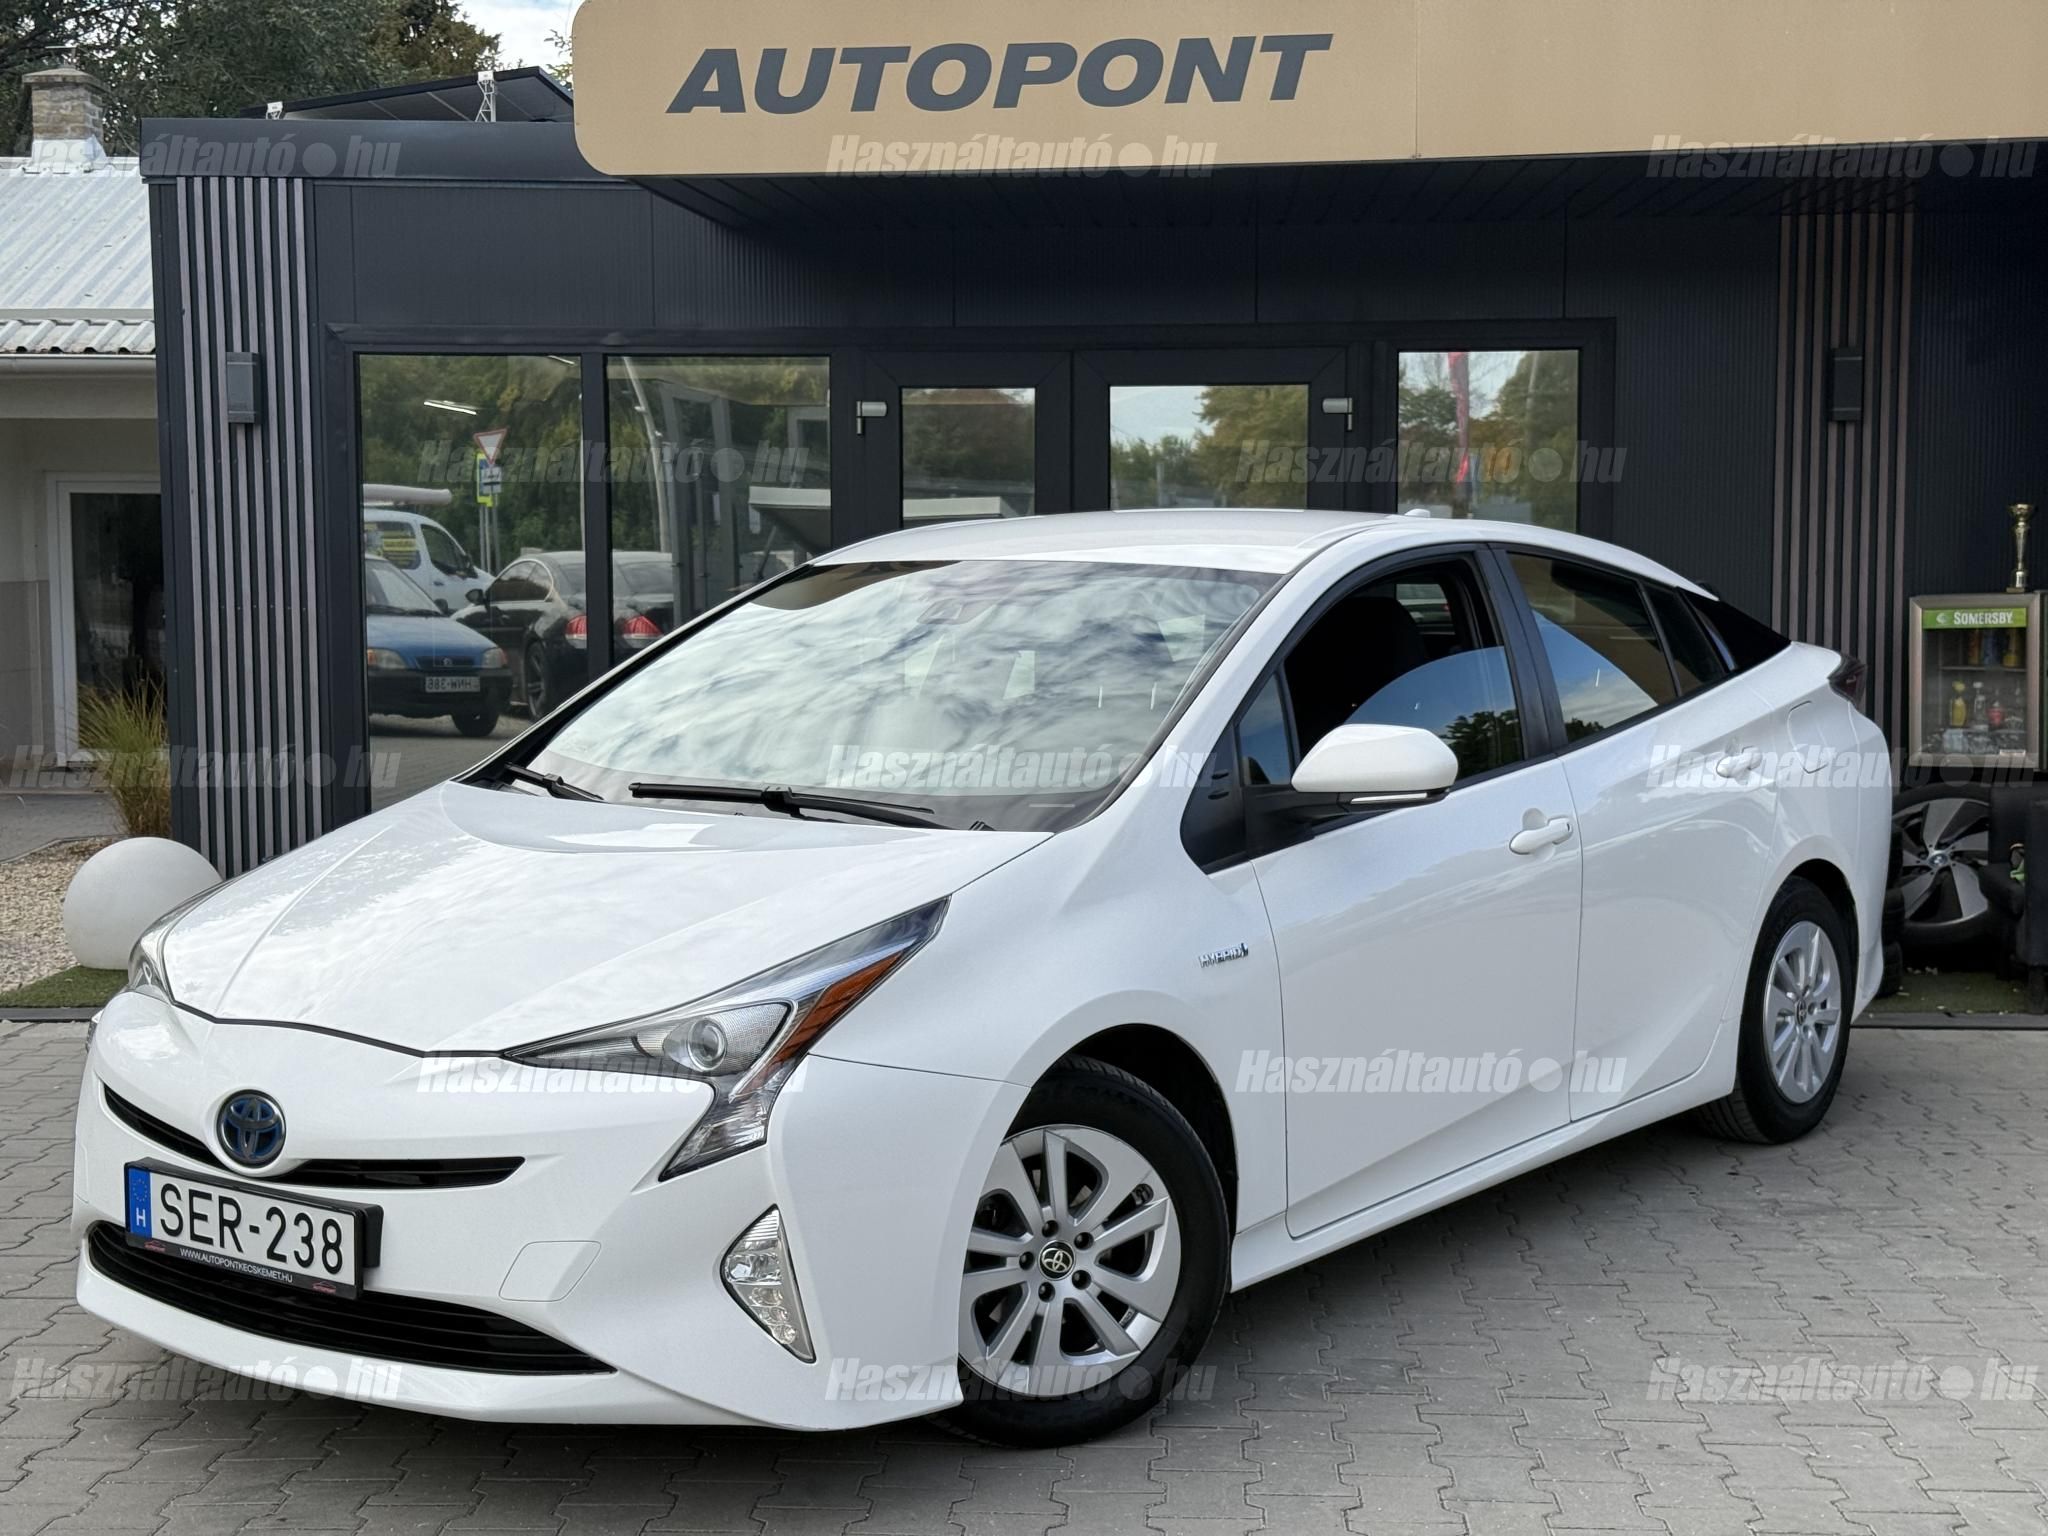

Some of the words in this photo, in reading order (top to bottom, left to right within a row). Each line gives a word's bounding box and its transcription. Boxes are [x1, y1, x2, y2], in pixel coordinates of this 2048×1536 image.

[665, 33, 1334, 114] AUTOPONT
[1953, 611, 2013, 625] SOMERSBY
[135, 1207, 147, 1228] H
[160, 1183, 343, 1274] SER-238
[179, 1248, 293, 1283] WWW.AUTOPONTKECSKEMET.HU
